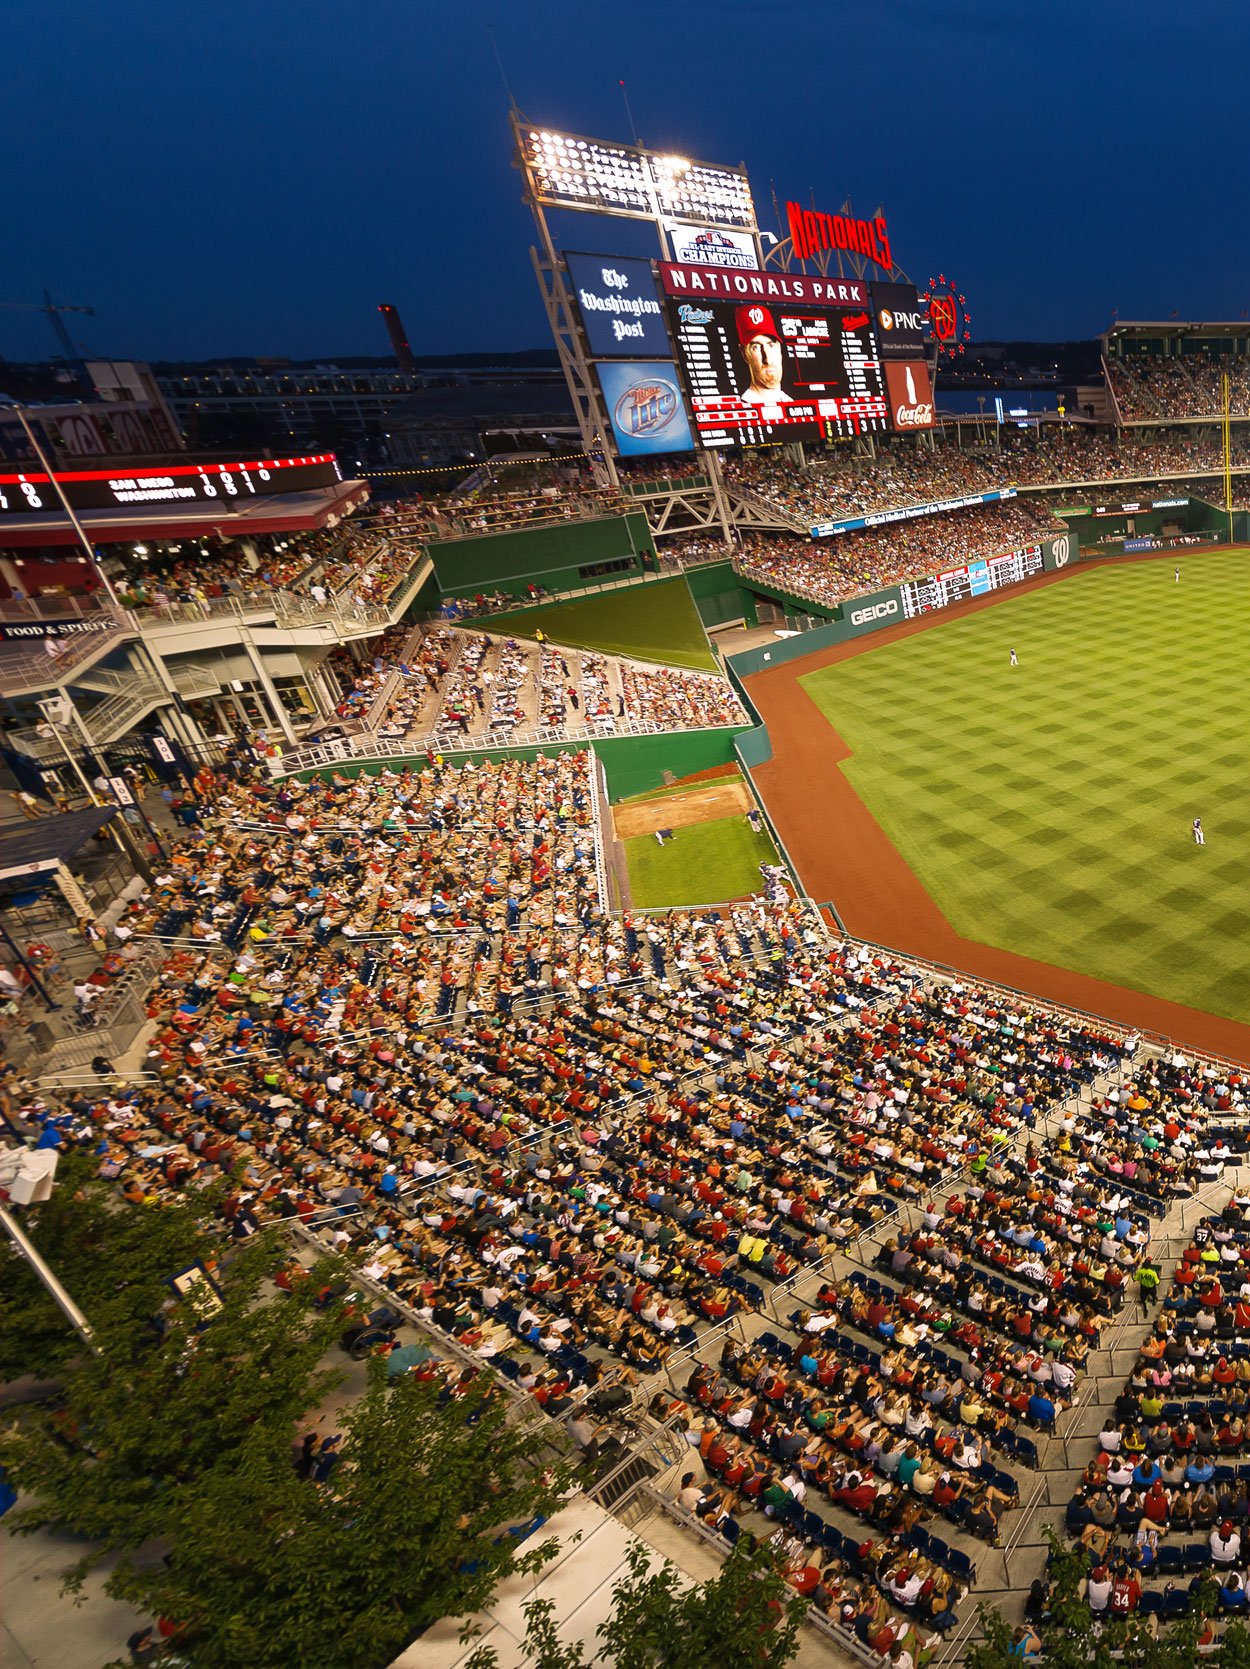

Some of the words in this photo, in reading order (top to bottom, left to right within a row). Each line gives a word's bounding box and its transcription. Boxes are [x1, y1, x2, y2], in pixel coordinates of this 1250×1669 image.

[785, 201, 893, 270] NATIONALS
[681, 249, 754, 267] CHAMPIONS
[601, 268, 629, 290] The
[670, 269, 804, 298] NATIONALS
[812, 282, 861, 301] PARK
[579, 289, 661, 317] Washington
[678, 304, 715, 325] Padres
[893, 311, 922, 329] PNC
[612, 319, 645, 341] Post
[630, 393, 672, 433] Lite
[860, 419, 867, 432] 3
[108, 479, 137, 490] SAN
[137, 477, 175, 489] DIEGO
[200, 473, 211, 485] 1
[220, 471, 233, 484] 0
[241, 470, 251, 482] 1
[258, 469, 271, 481] 0
[204, 484, 217, 497] 0
[224, 483, 238, 495] 5
[245, 482, 256, 493] 1
[1152, 500, 1189, 508] nationals.com
[850, 599, 898, 626] GEICO
[5, 626, 44, 637] FOOD
[46, 625, 58, 635] &
[158, 739, 171, 760] 101
[115, 780, 130, 802] 102
[1196, 1232, 1208, 1242] 37
[1114, 1591, 1130, 1608] 34
